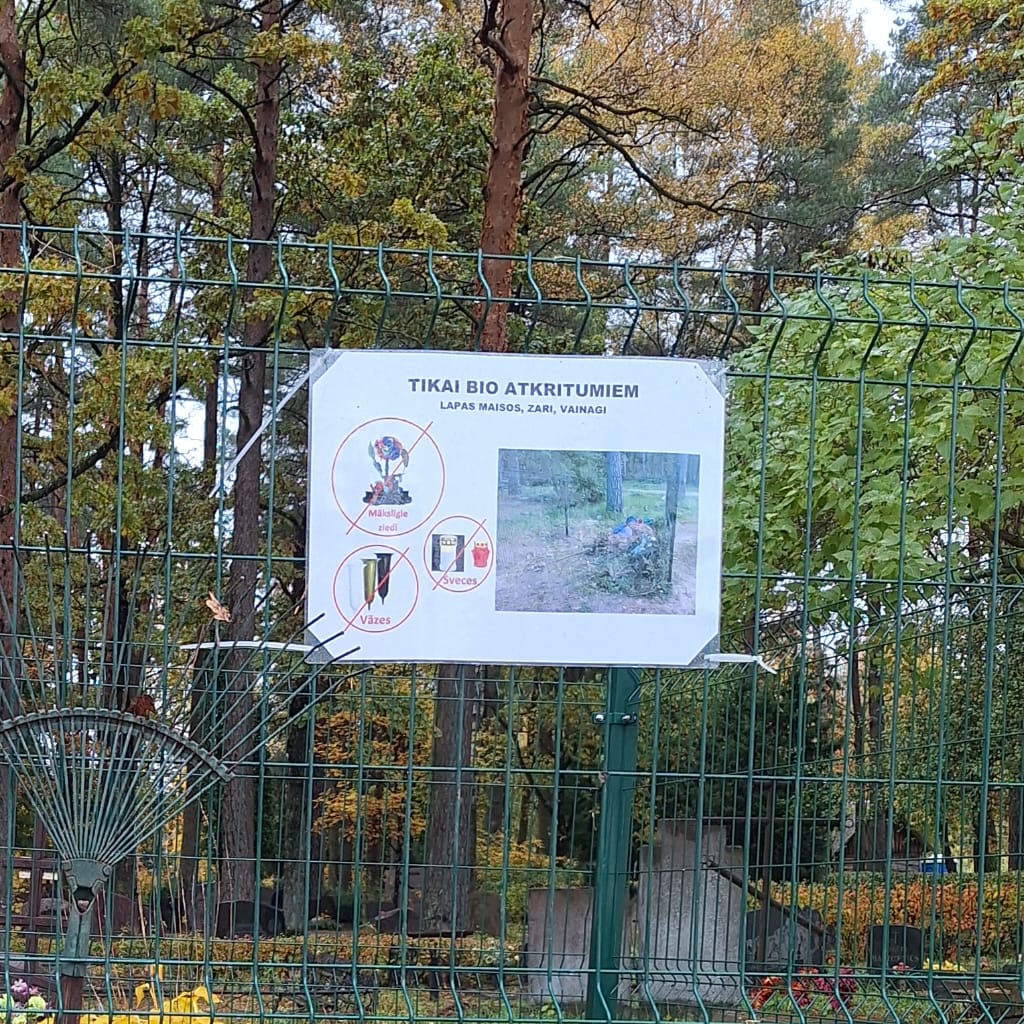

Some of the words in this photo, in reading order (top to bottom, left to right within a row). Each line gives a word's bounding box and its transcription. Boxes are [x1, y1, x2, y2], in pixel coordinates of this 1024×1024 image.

[408, 378, 460, 393] TIKAI
[466, 380, 499, 395] BIO
[504, 381, 640, 398] ATKRITUMIEM
[440, 401, 476, 411] LAPAS
[478, 402, 525, 413] MAISOS,
[527, 404, 557, 414] ZARI,
[560, 405, 607, 415] VAINAGI
[378, 523, 398, 532] ziedi
[443, 575, 478, 586] Sveces
[360, 614, 392, 625] Vāzes
